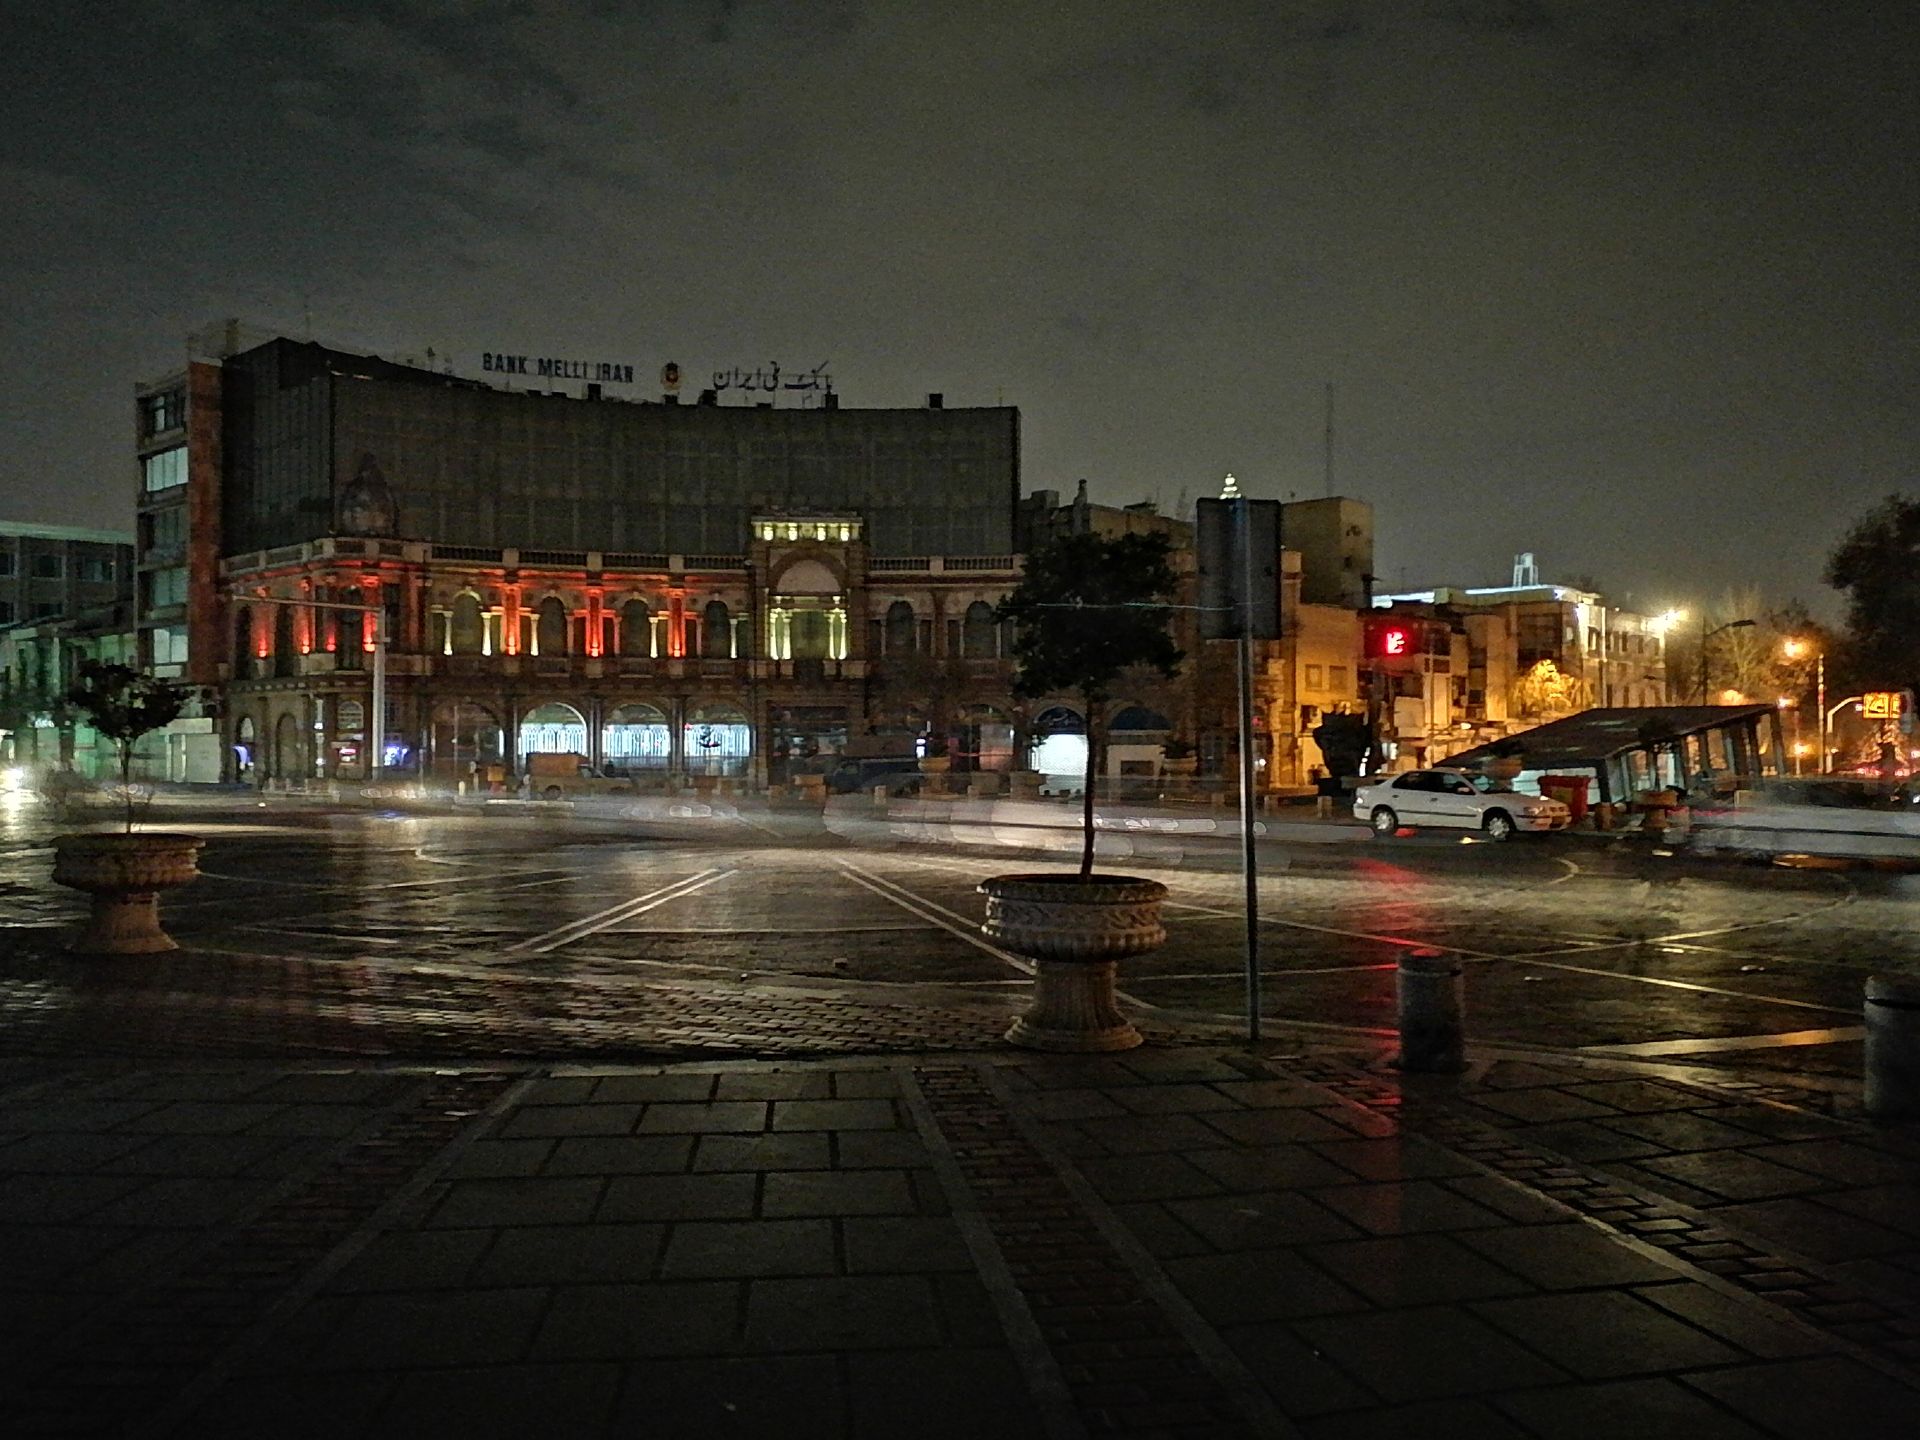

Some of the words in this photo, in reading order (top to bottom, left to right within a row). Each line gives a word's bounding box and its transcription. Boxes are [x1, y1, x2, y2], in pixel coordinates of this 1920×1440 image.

[482, 352, 528, 375] BANK
[537, 358, 588, 380] MELLI
[596, 362, 634, 383] IRAN
[712, 366, 761, 391] ایران
